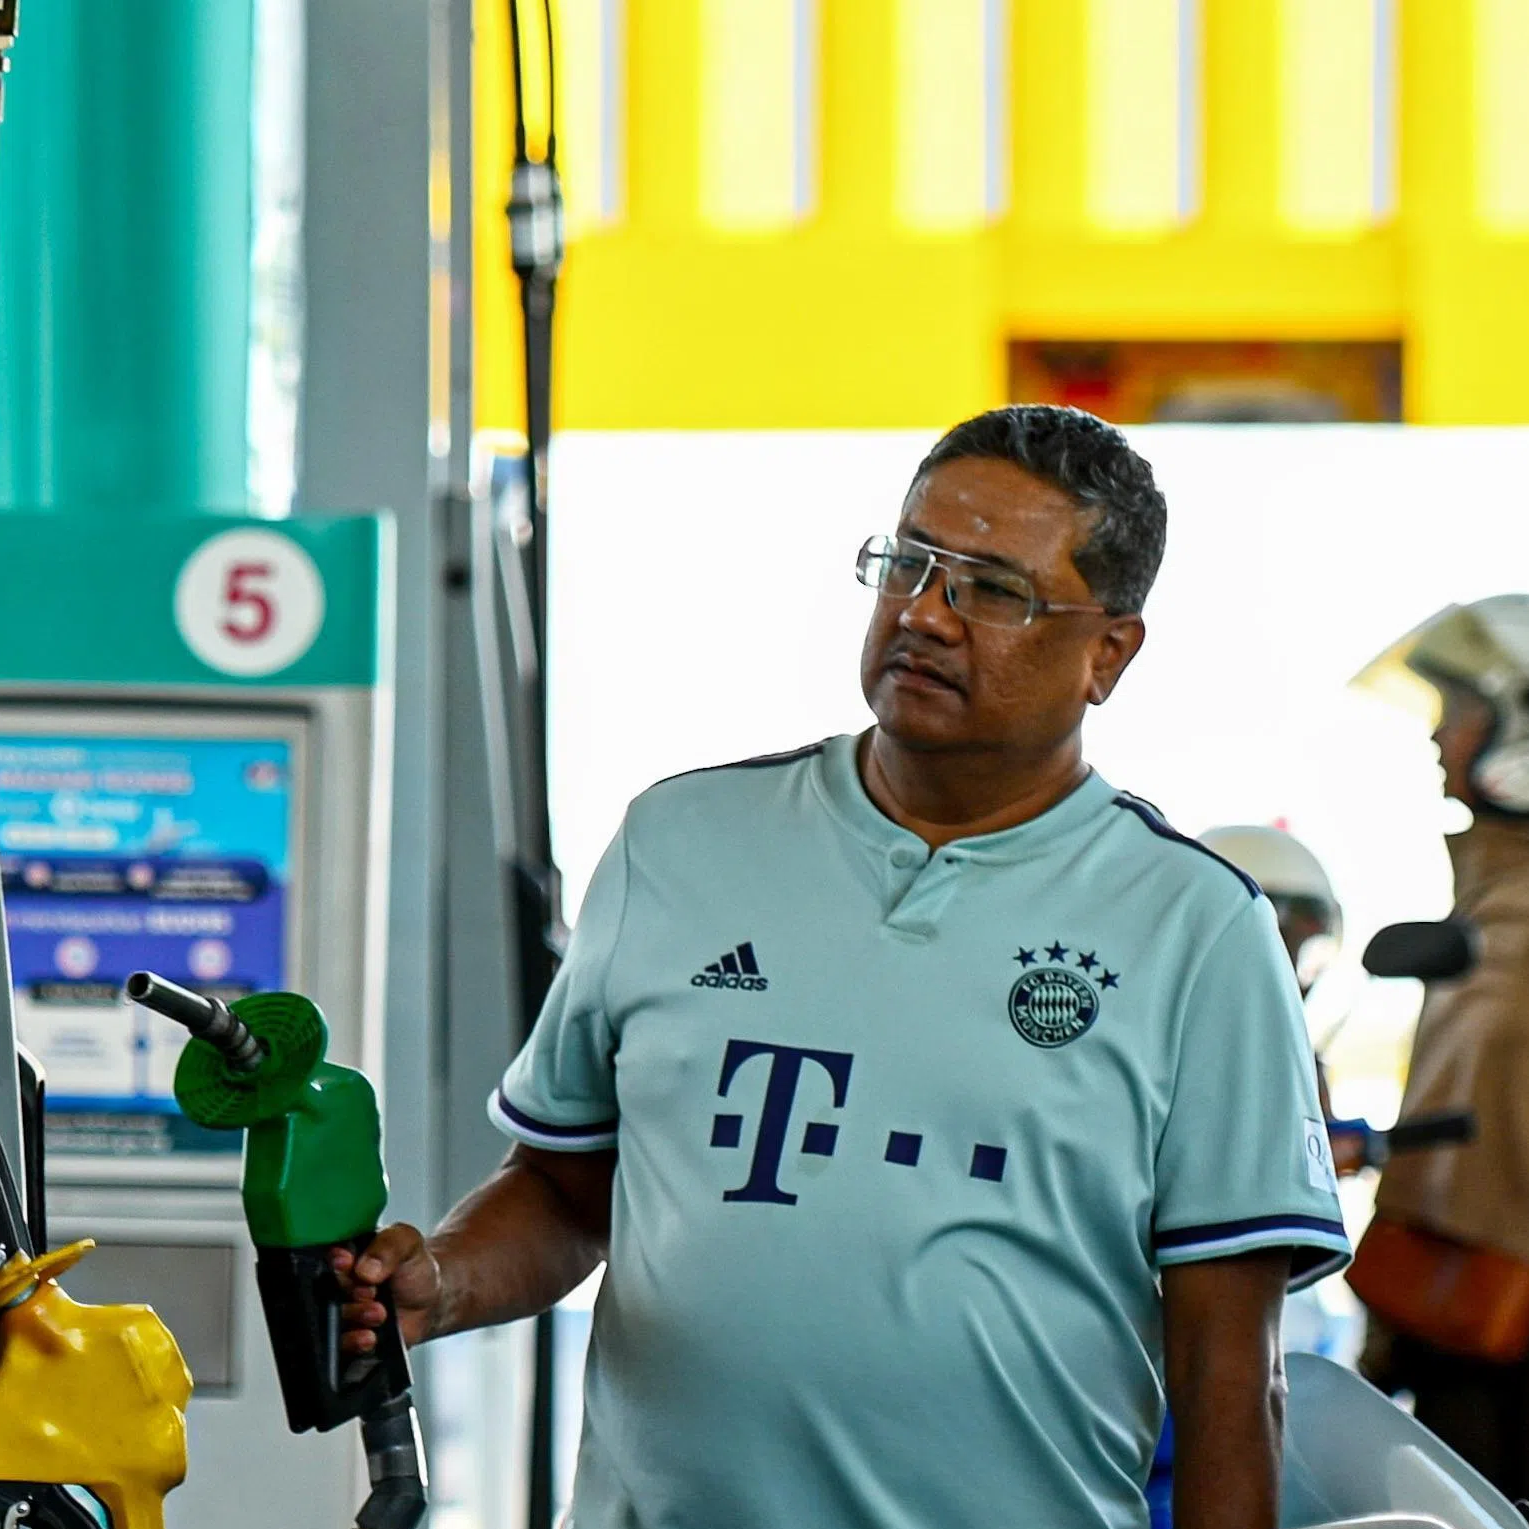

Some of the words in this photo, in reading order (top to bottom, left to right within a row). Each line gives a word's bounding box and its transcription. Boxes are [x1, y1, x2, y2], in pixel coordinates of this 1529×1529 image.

[221, 563, 274, 642] 5
[691, 973, 769, 991] adidas
[718, 1039, 854, 1206] T
